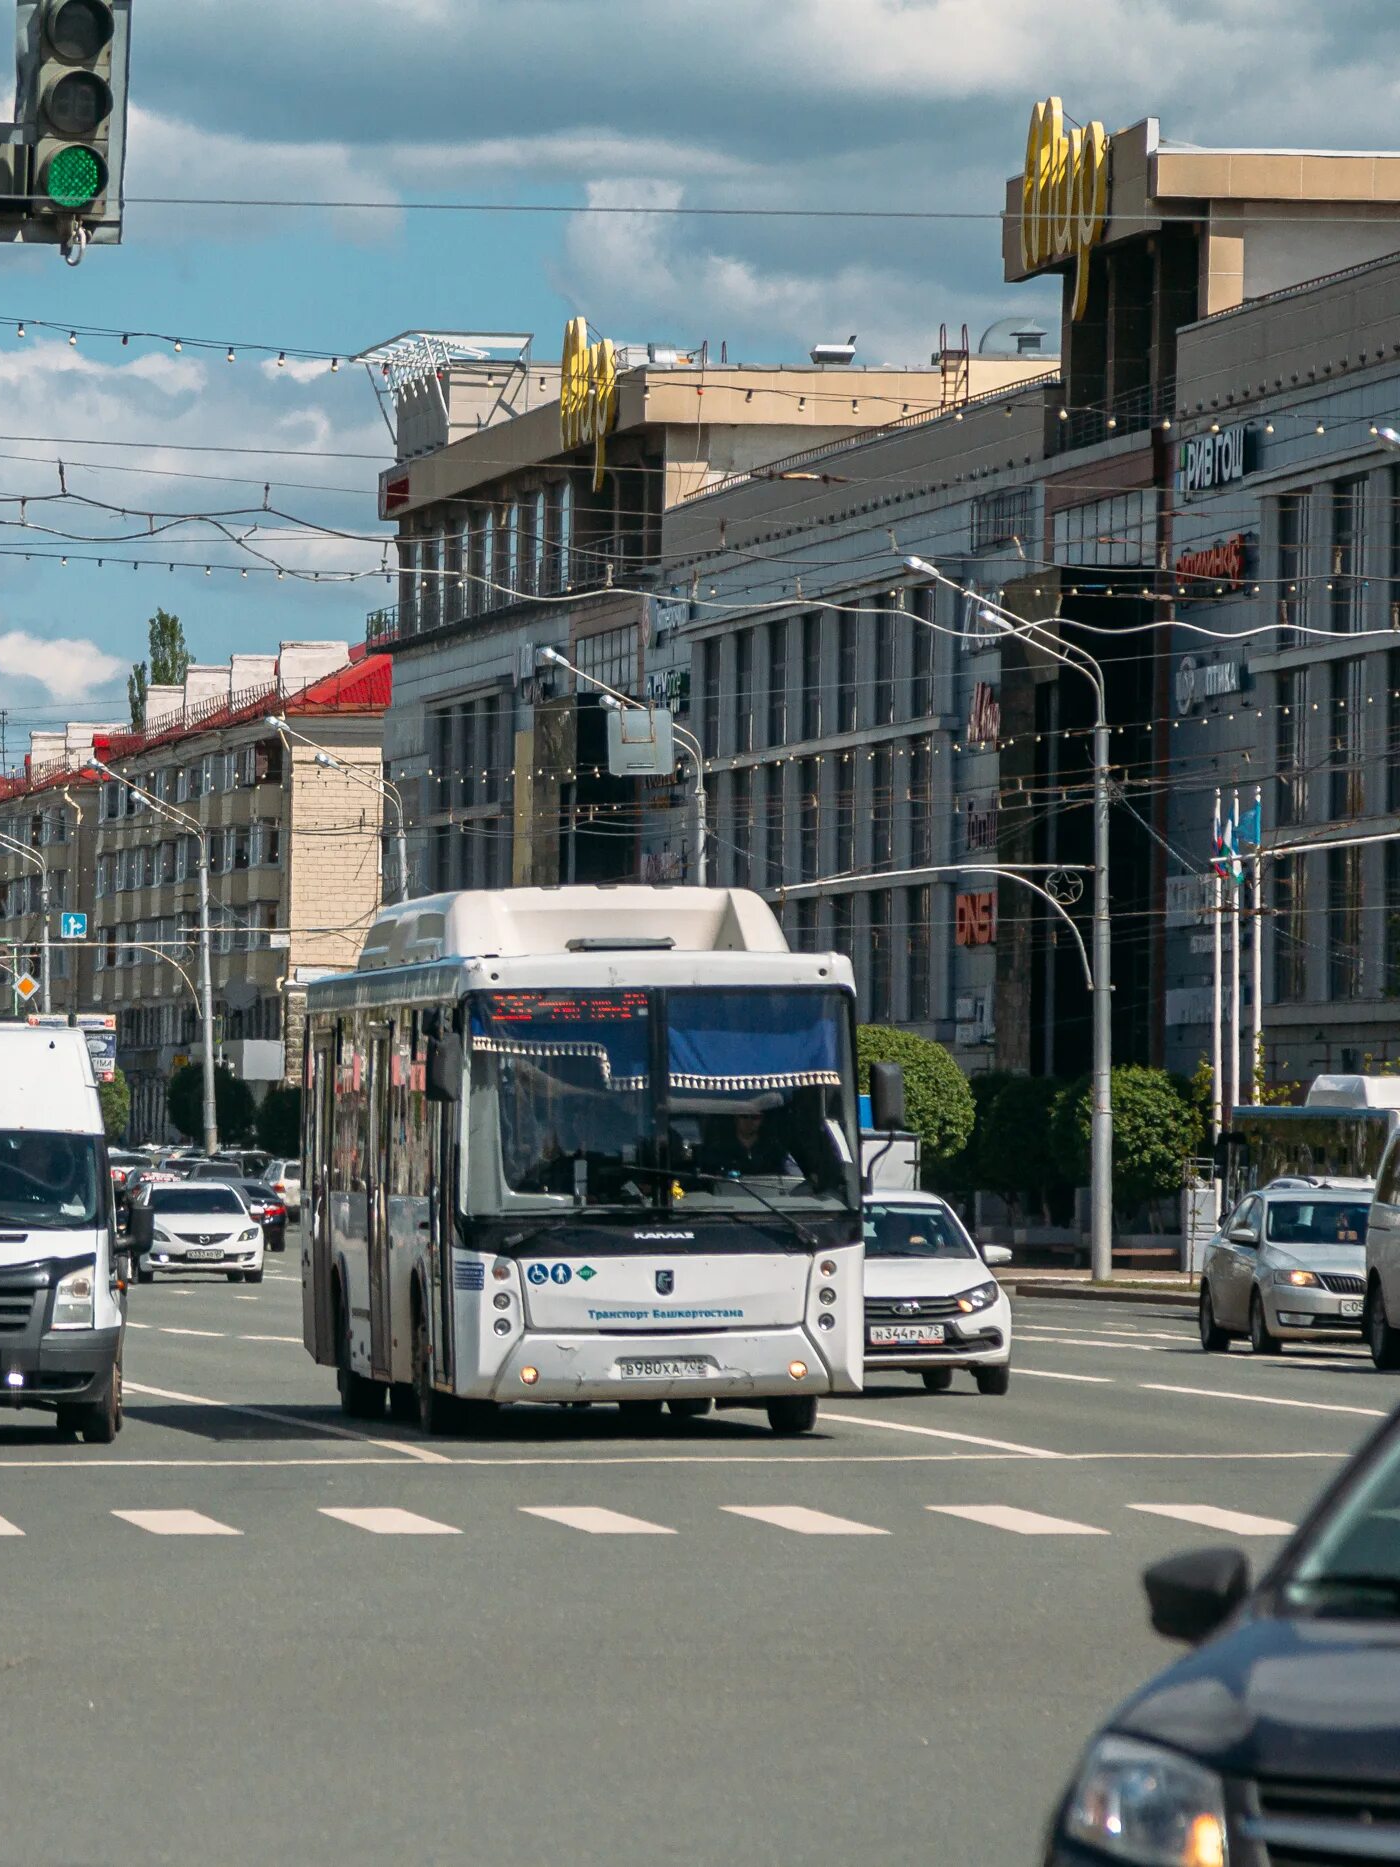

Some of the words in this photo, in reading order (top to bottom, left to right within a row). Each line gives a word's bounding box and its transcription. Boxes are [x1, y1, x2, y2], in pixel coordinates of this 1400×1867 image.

[1186, 437, 1214, 490] РИВ
[1214, 428, 1244, 484] ГОШ
[588, 1309, 649, 1321] Транспорт
[652, 1308, 744, 1320] Башкортостана
[875, 1327, 925, 1340] Н344РА
[626, 1360, 680, 1376] В980ХА
